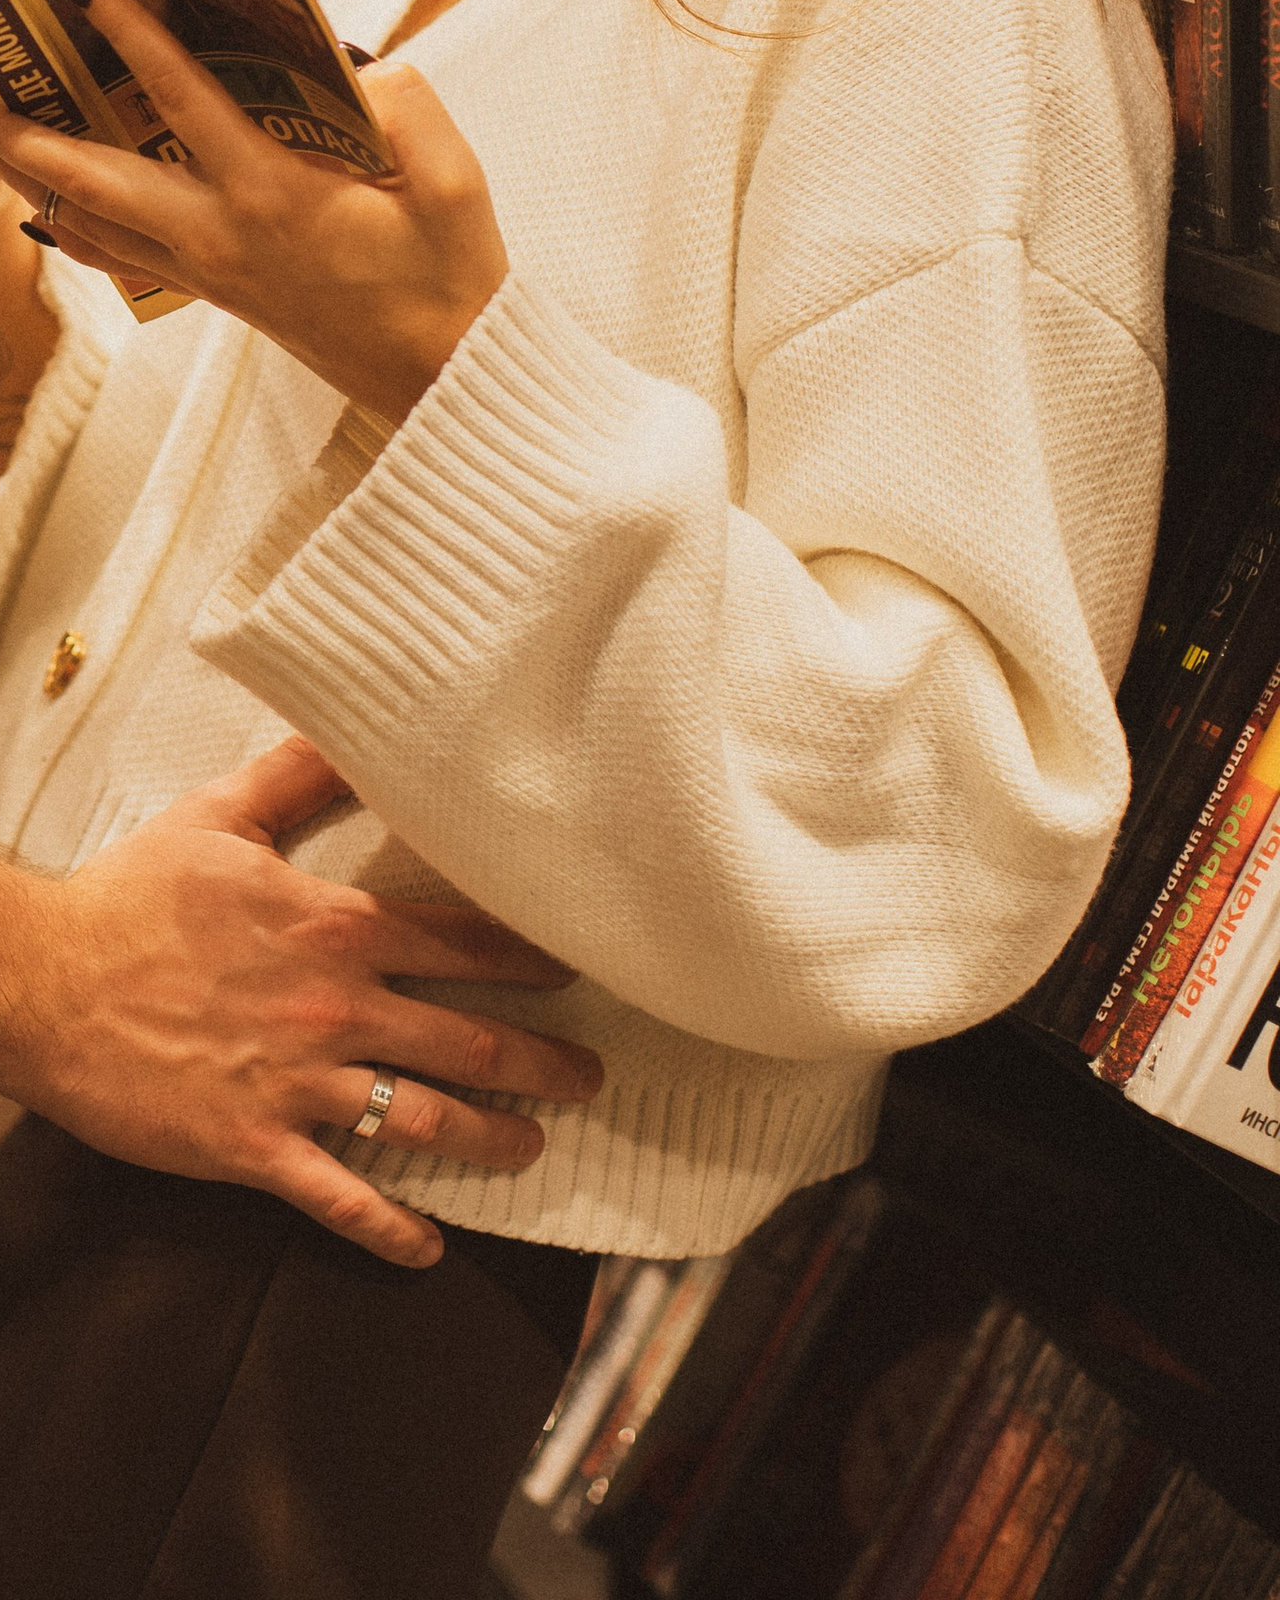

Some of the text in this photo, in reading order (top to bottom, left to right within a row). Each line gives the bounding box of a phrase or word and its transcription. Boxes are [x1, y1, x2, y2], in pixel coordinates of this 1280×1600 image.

[9, 69, 59, 104] ДЕ
[1197, 724, 1256, 827] КОТОРЫЙ
[1131, 792, 1253, 1005] Нетопырь
[1150, 829, 1204, 918] УМИРАЛ
[1118, 923, 1154, 977] СЕМЬ
[1094, 982, 1122, 1023] РАЗ
